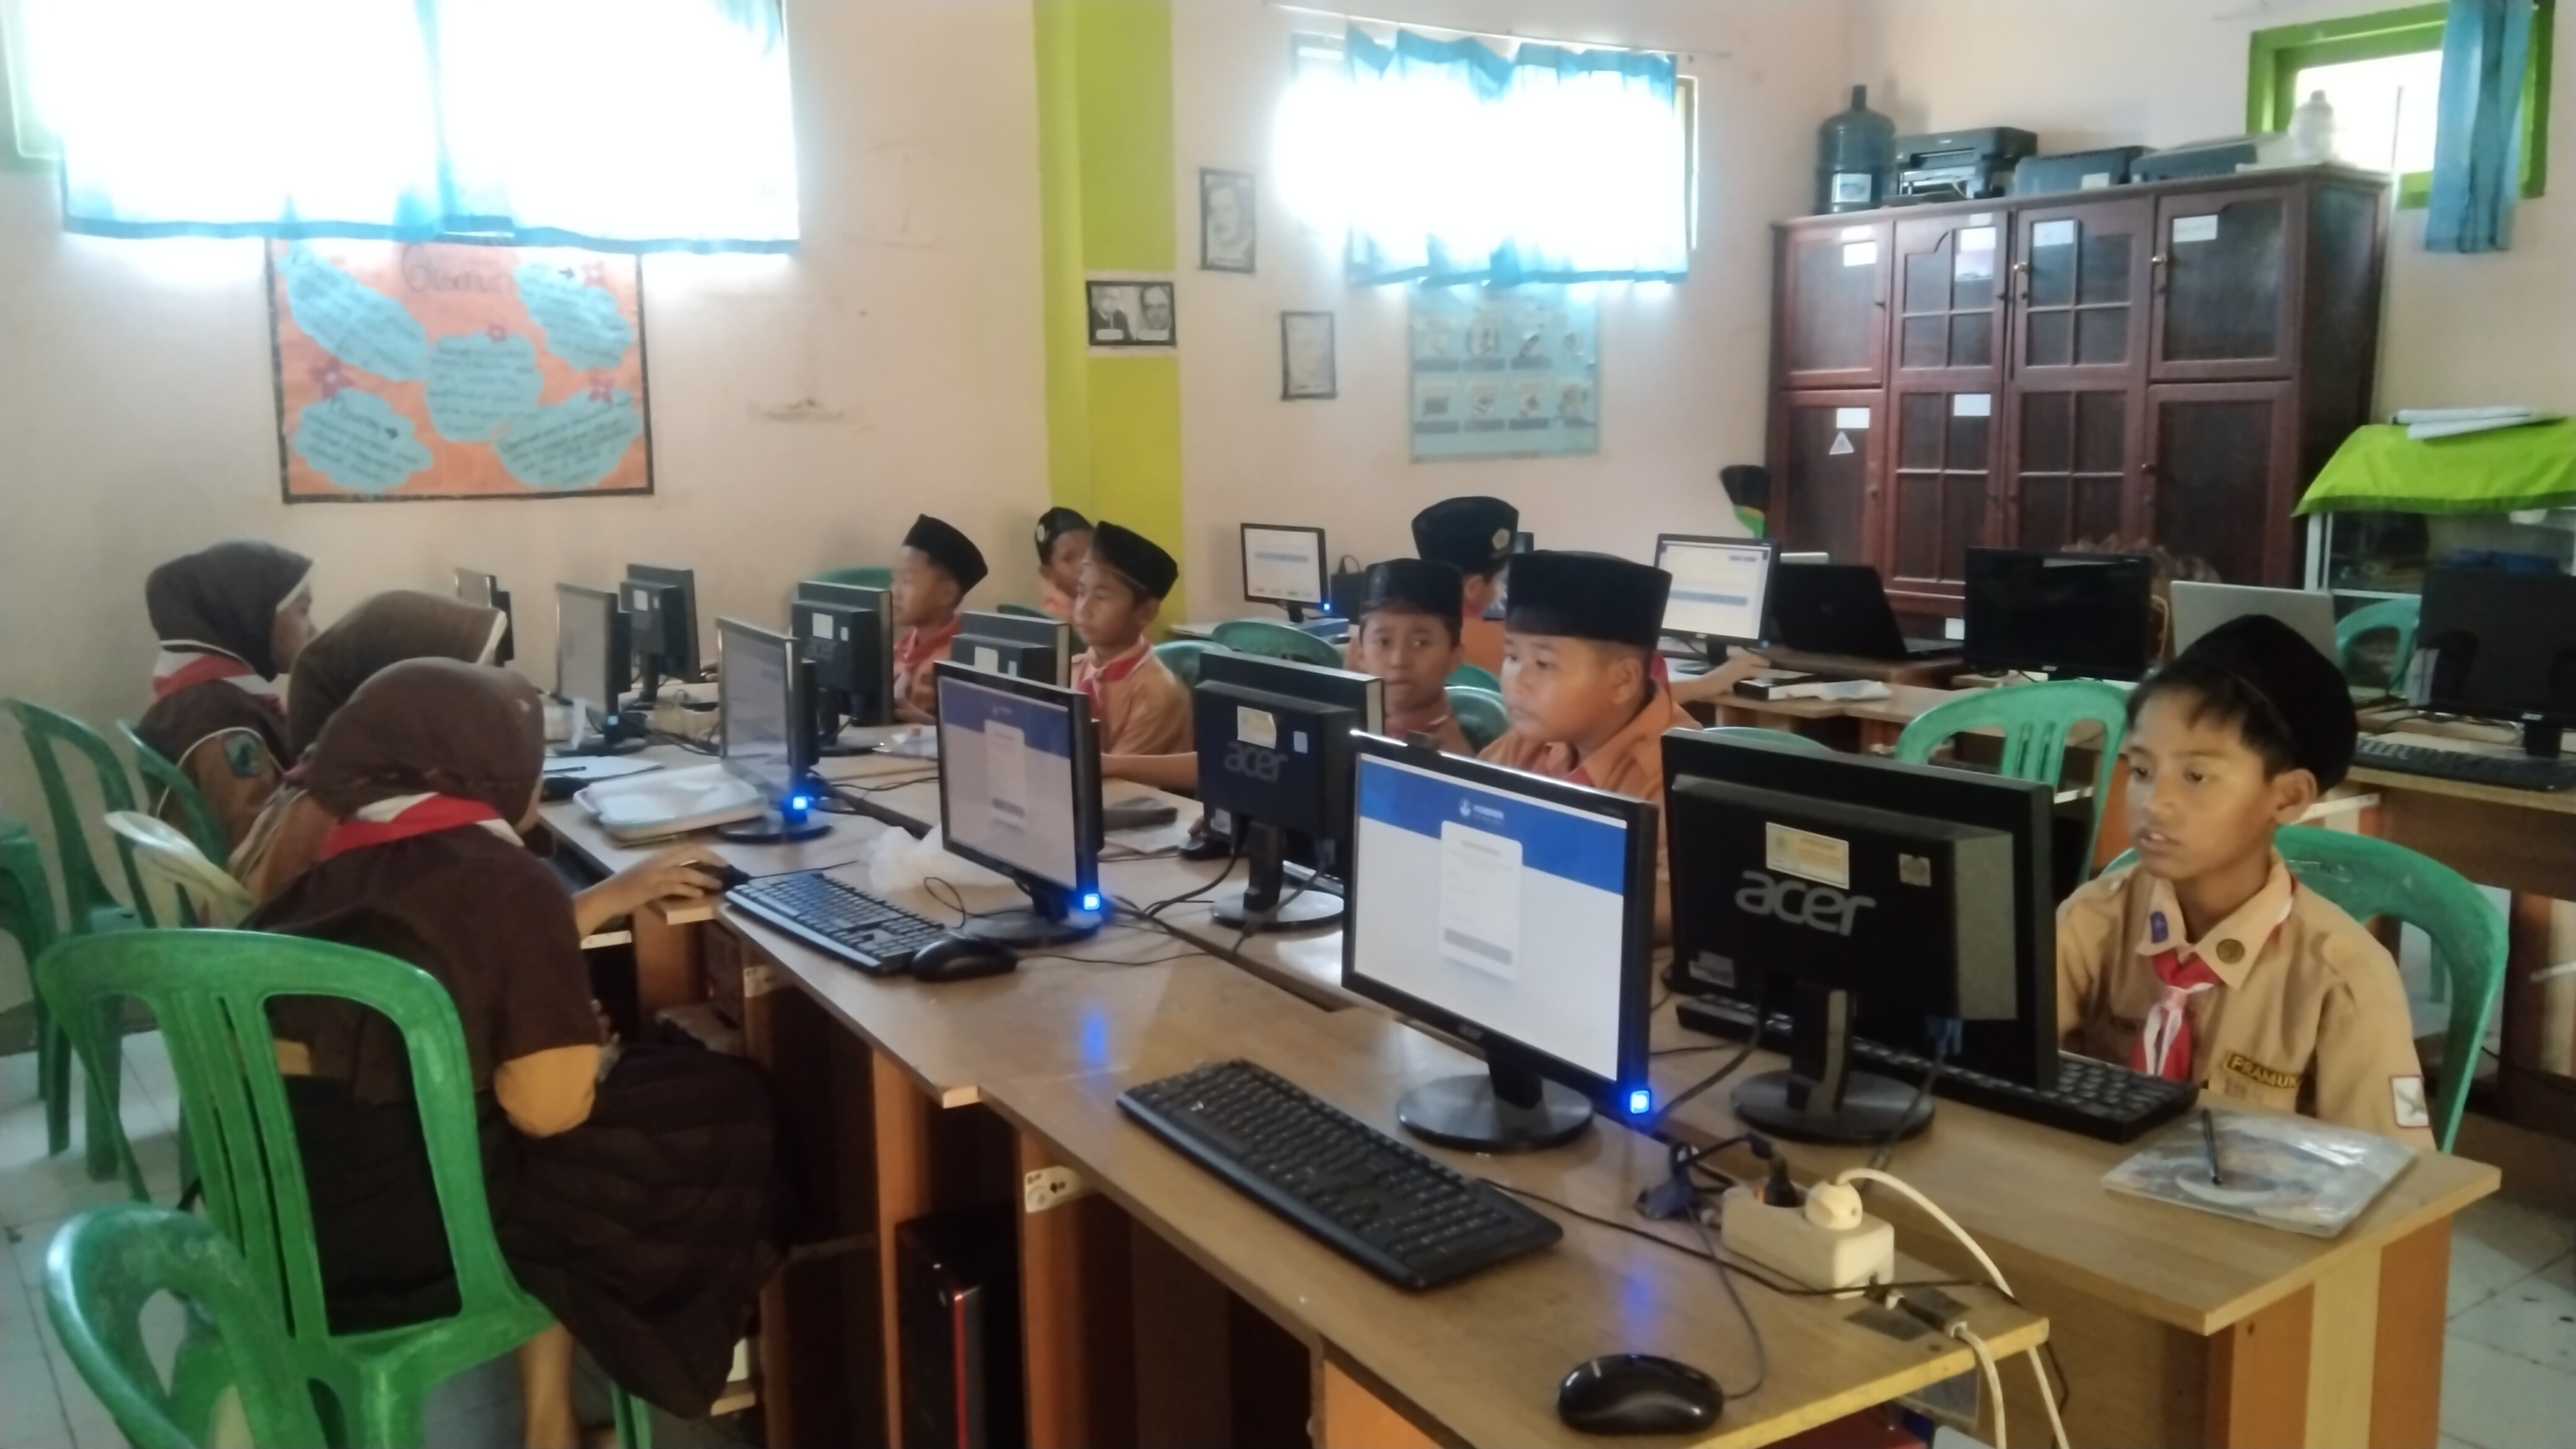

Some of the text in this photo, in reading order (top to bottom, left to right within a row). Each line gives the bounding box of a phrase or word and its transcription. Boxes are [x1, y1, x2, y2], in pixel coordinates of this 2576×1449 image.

[1224, 741, 1289, 785] acer
[1735, 869, 1877, 937] acer
[2230, 1055, 2299, 1088] PRAMUK
